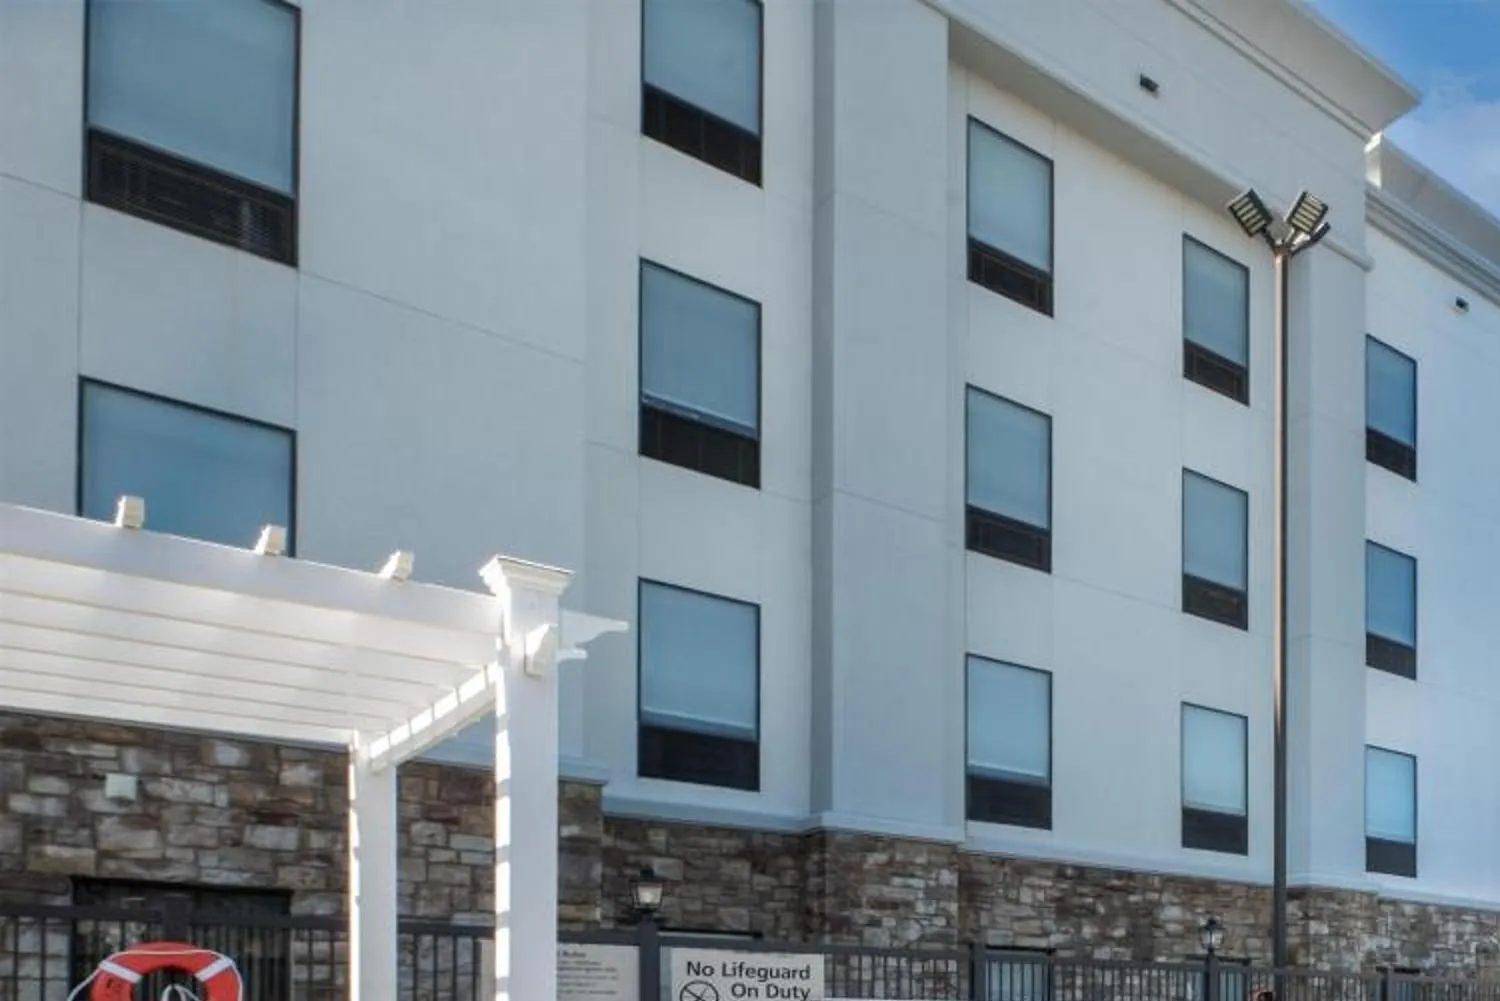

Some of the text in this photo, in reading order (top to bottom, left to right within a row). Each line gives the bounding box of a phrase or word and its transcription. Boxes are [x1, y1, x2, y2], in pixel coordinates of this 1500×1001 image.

[686, 961, 811, 983] No Lifeguard
[731, 982, 759, 998] On
